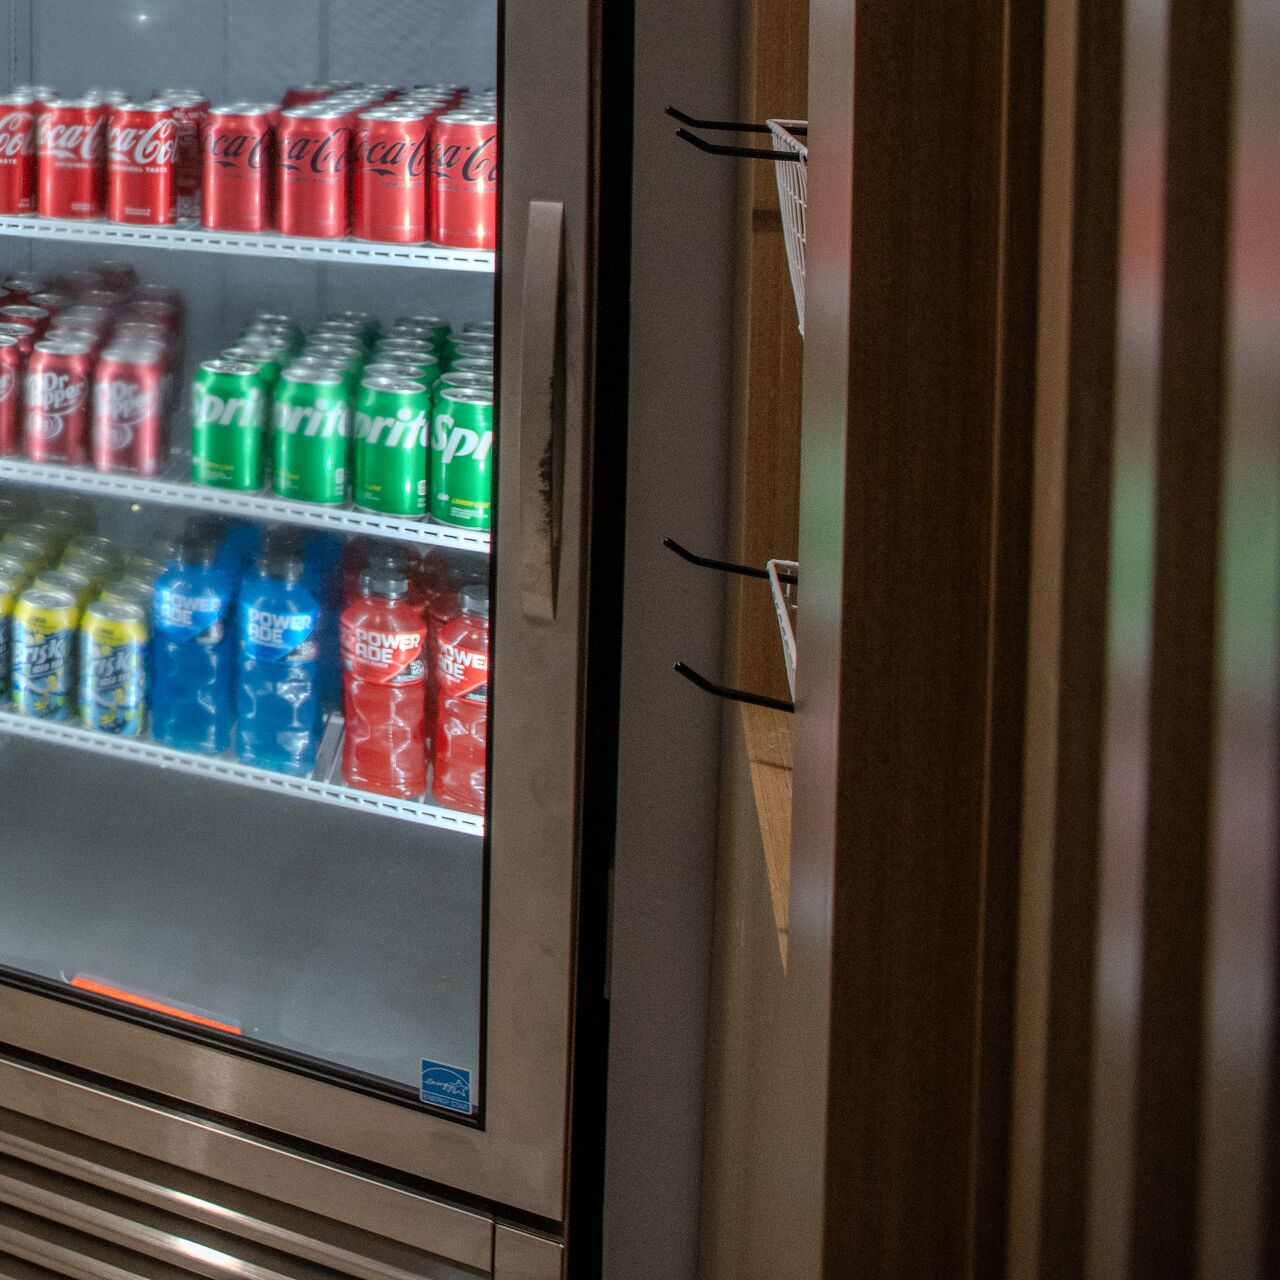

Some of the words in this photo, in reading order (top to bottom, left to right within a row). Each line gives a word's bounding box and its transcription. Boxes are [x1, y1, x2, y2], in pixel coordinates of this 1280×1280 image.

[47, 372, 70, 389] Dr
[161, 590, 221, 612] POWER
[161, 604, 192, 625] ADE
[249, 608, 312, 630] POWER
[248, 625, 283, 644] ADE
[356, 628, 420, 651] POWER
[355, 643, 393, 663] ADE
